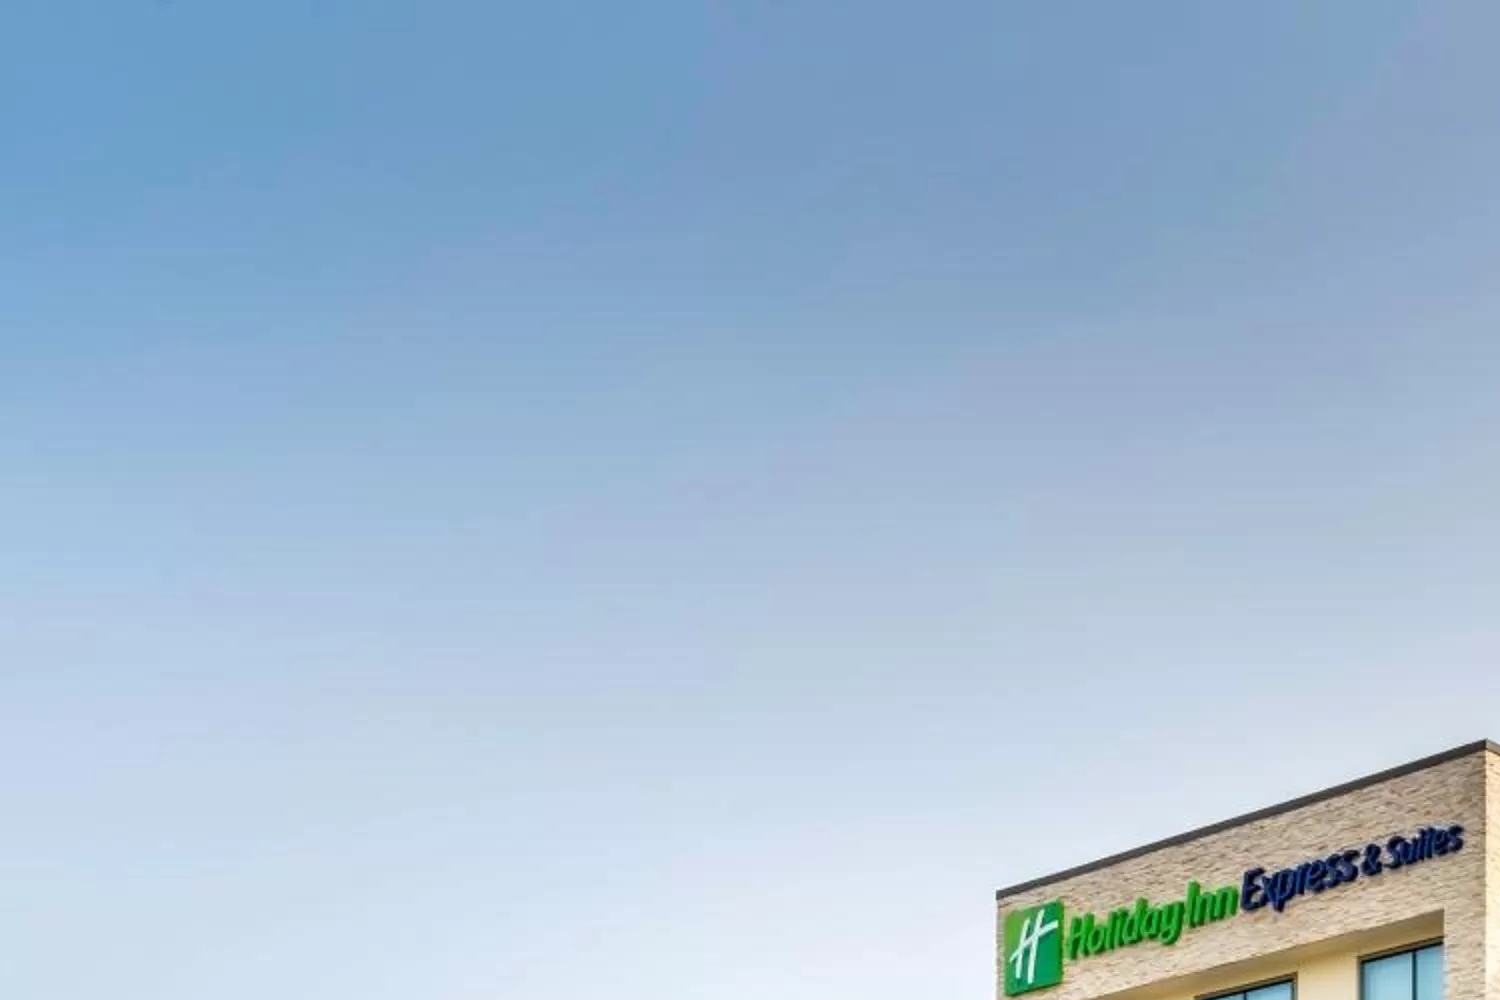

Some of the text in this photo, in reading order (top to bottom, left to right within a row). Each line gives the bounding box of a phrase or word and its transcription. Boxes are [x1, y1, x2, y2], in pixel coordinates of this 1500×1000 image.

[1067, 824, 1465, 960] Holiday Inn Express & Suites
